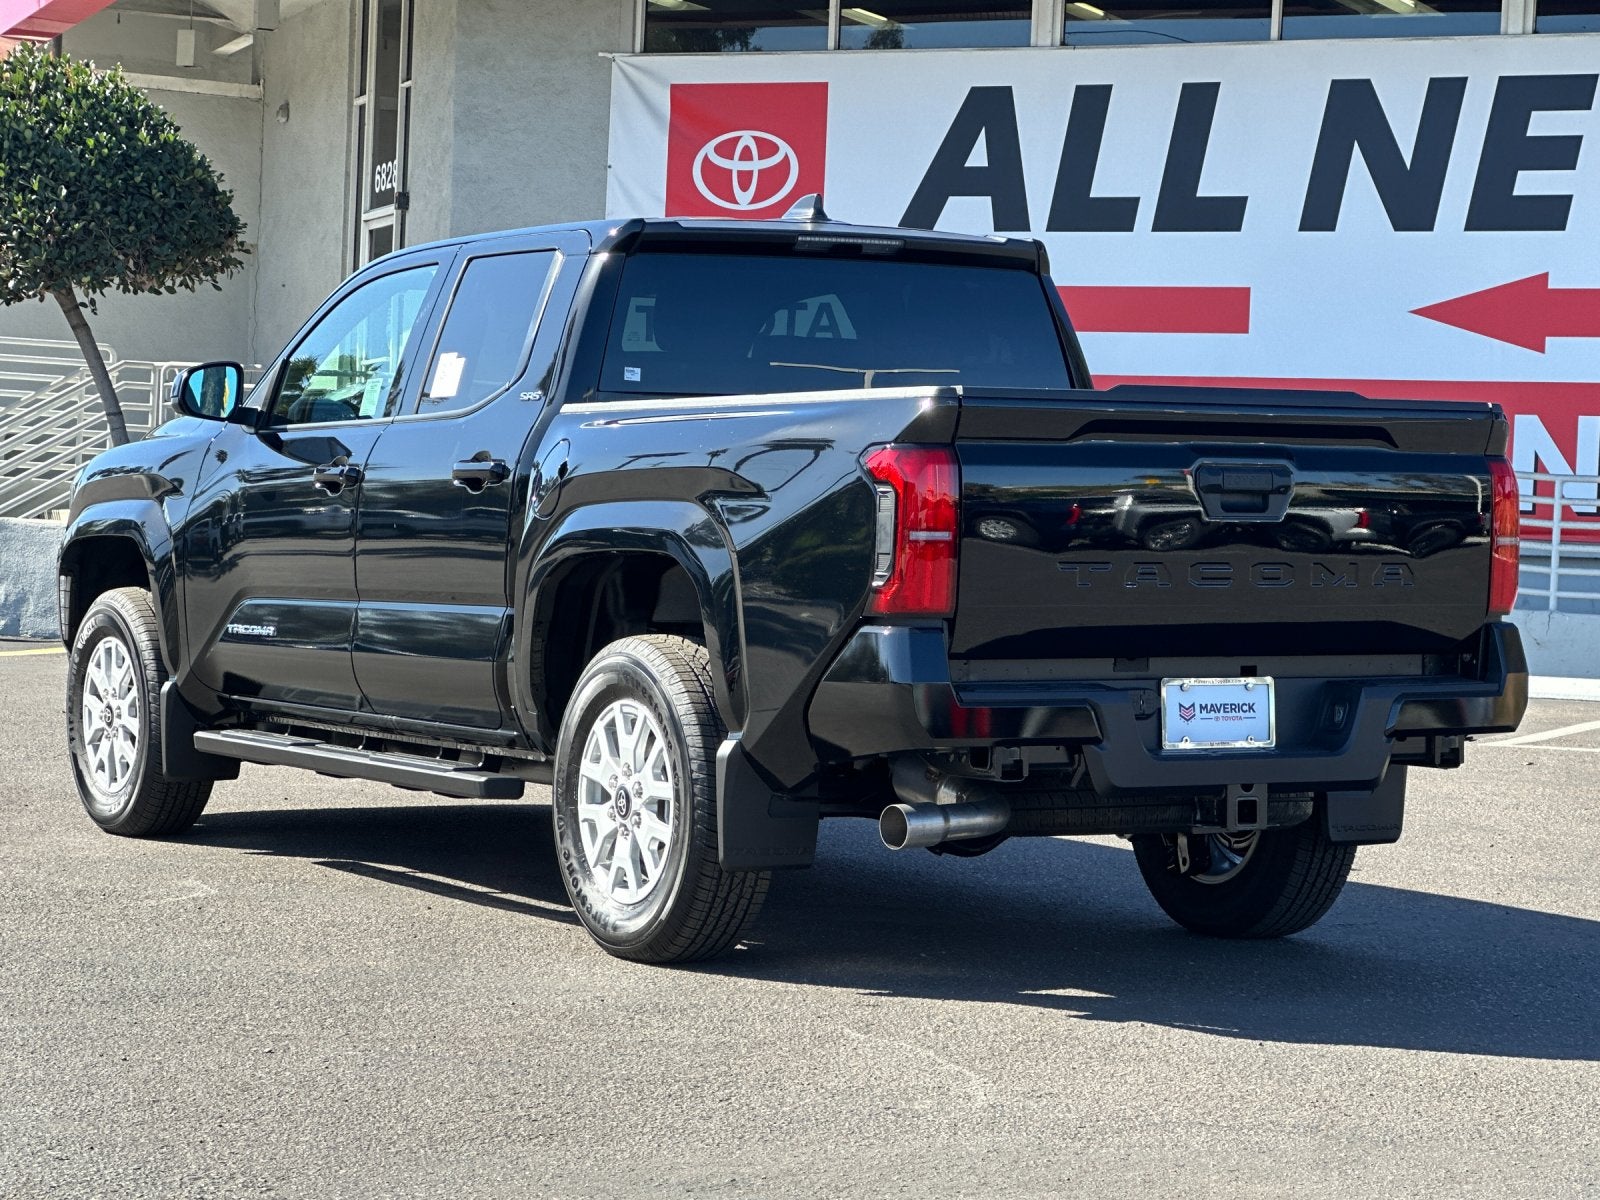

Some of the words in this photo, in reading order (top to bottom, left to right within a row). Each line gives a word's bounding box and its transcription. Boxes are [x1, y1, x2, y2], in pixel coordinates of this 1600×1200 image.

[898, 82, 1248, 232] ALL
[1298, 74, 1599, 232] NE
[1057, 561, 1414, 588] TACOMA
[227, 623, 276, 636] TACOMA
[1200, 702, 1256, 714] MAVERICK
